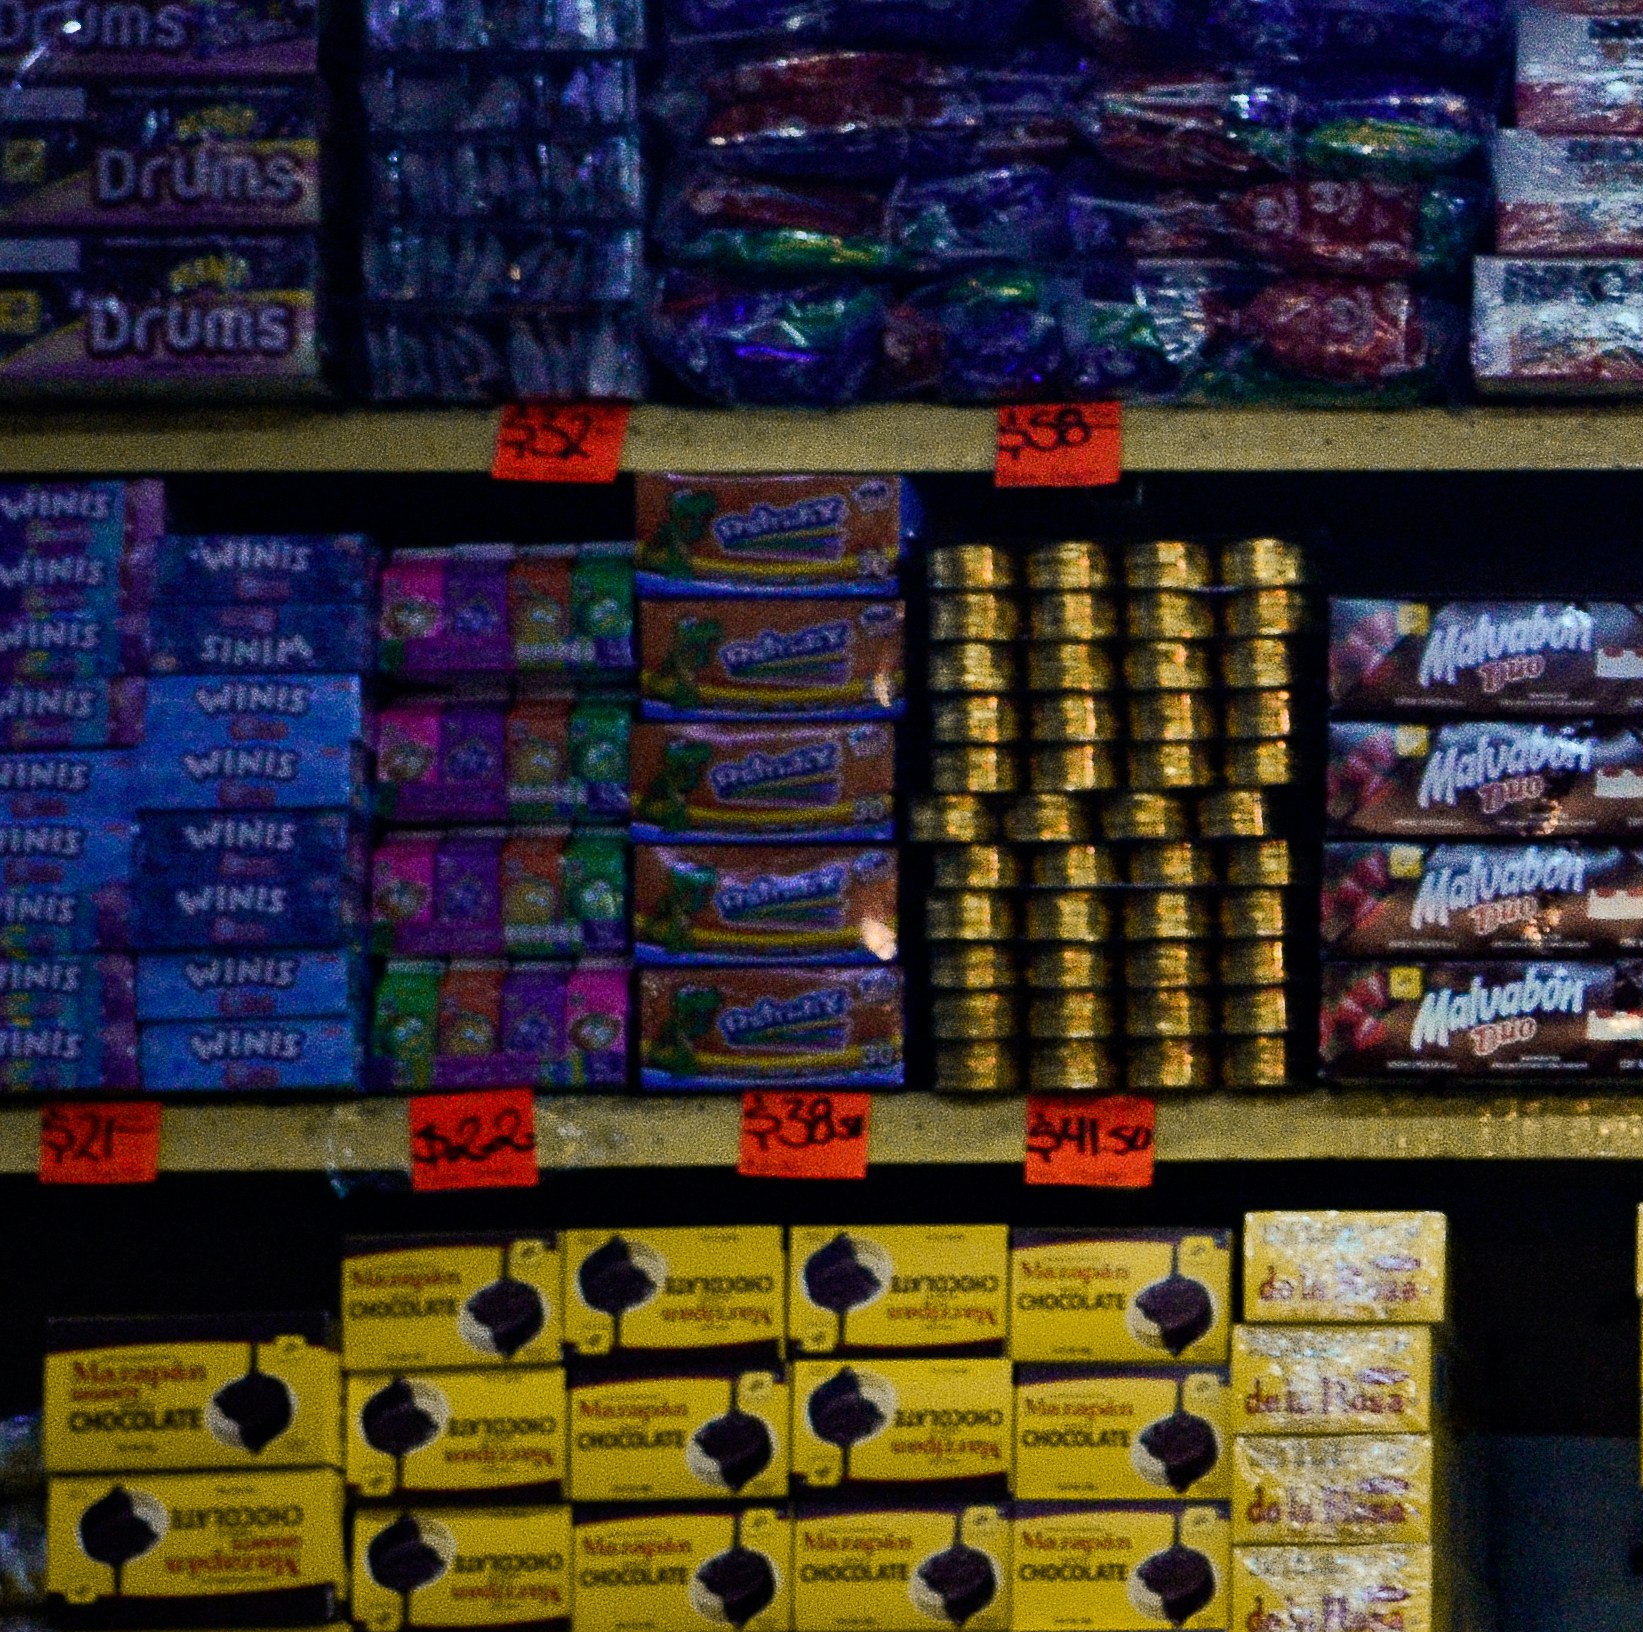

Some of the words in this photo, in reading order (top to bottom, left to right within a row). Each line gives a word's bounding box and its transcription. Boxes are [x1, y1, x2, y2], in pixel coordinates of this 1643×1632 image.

[92, 146, 299, 203] Drums
[87, 301, 290, 354] Drums
[6, 491, 110, 519] WINIS
[200, 540, 311, 572] WINIS
[200, 632, 311, 664] WINIS
[195, 683, 309, 715] WINIS
[184, 749, 297, 780] WINIS
[184, 820, 296, 851] WINIS
[175, 885, 287, 915] WINIS
[185, 956, 295, 987] WINIS
[190, 1028, 302, 1061] WINIS
[348, 1301, 458, 1320] CHOCOLATE
[1018, 1293, 1126, 1312] CHOCOLATE
[69, 1409, 203, 1434] CHOCOLATE
[578, 1431, 686, 1450] CHOCOLATE
[1023, 1429, 1132, 1449] CHOCOLATE
[580, 1567, 689, 1587] CHOCOLATE
[801, 1563, 910, 1583] CHOCOLATE
[1019, 1563, 1128, 1582] CHOCOLATE
